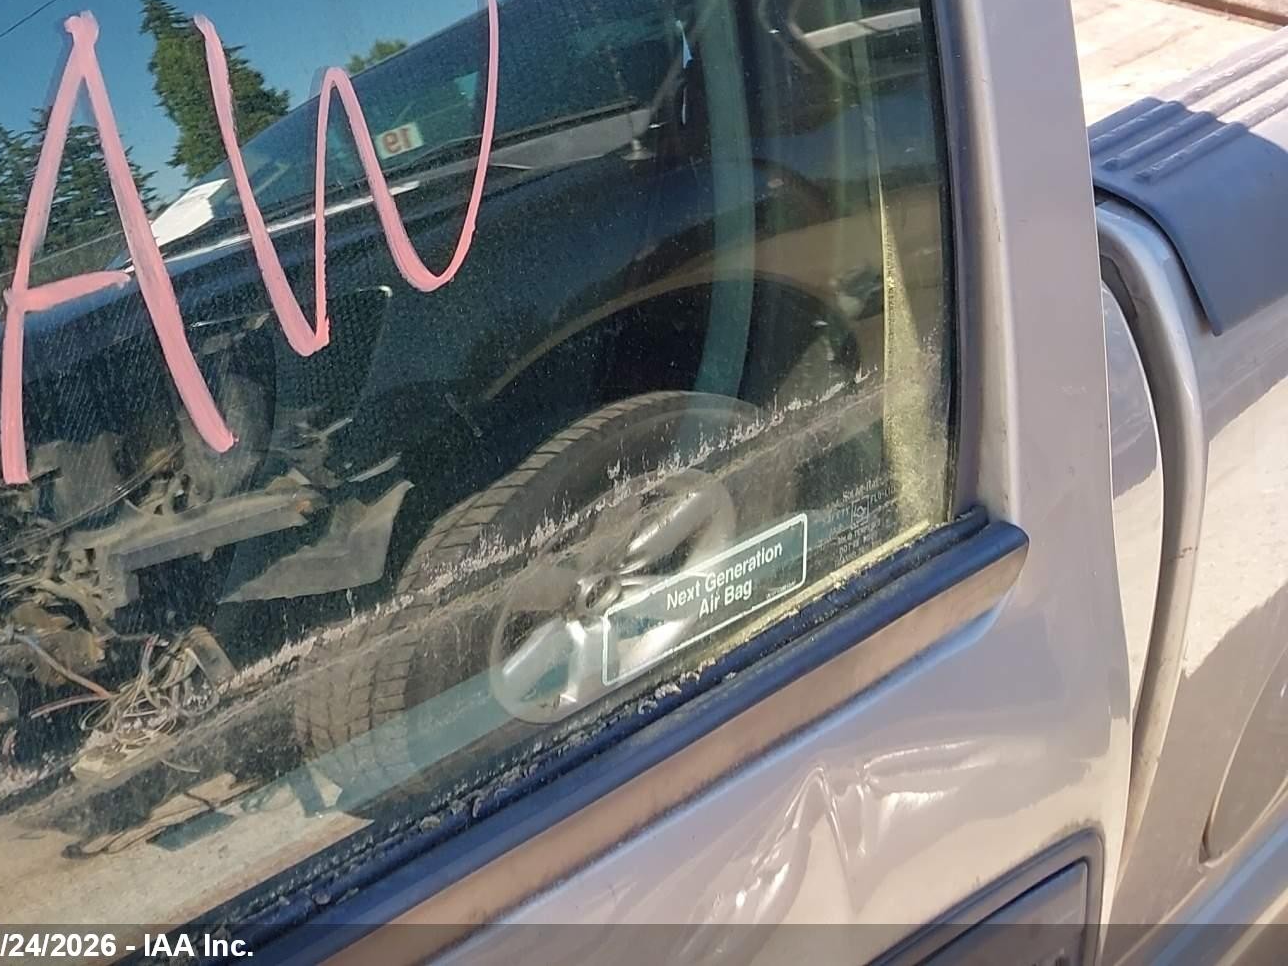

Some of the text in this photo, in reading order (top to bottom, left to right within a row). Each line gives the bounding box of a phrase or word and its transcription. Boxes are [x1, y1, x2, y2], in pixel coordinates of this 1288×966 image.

[666, 579, 701, 611] Next
[704, 542, 783, 593] Generation
[698, 592, 721, 619] Air
[724, 579, 753, 607] Bag
